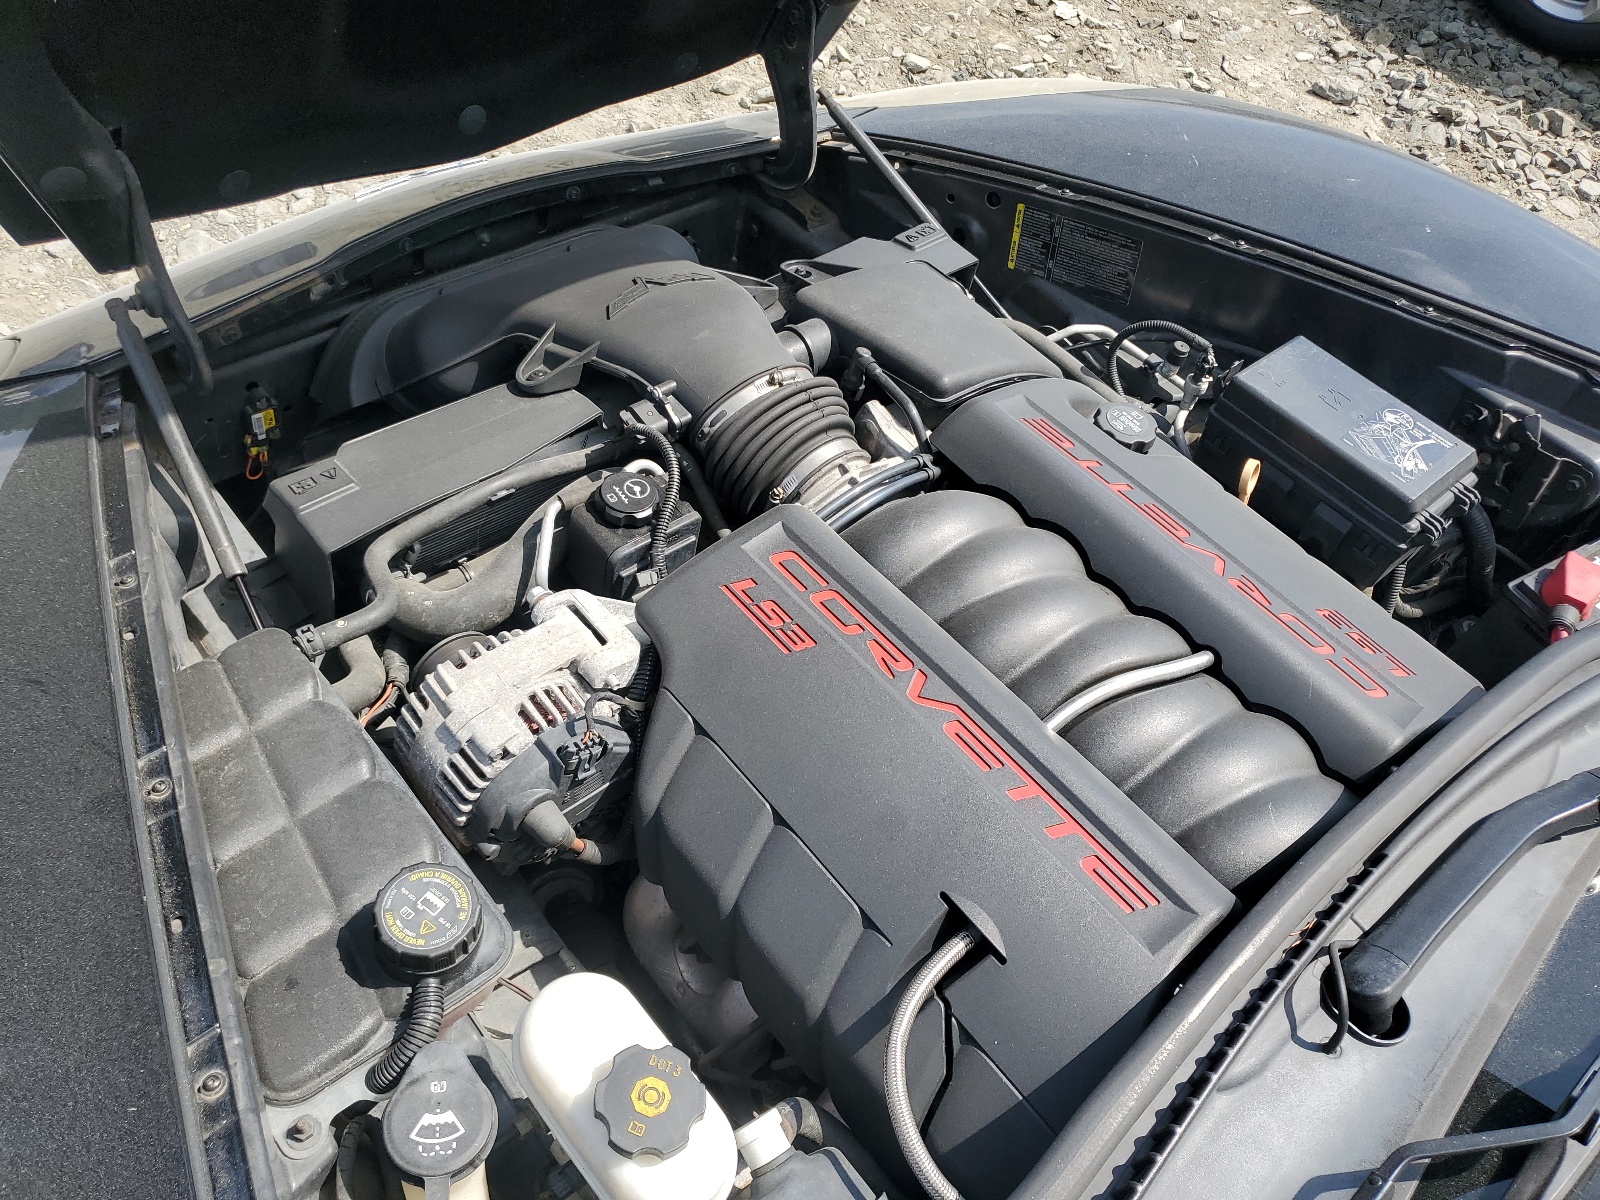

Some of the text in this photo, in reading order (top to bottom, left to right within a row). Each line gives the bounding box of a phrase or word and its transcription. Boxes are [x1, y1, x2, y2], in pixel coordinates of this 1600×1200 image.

[1021, 418, 1389, 698] CORVETTE
[720, 578, 817, 654] LS3
[1315, 607, 1417, 677] LS3
[769, 551, 1160, 913] CORVETTE
[440, 872, 461, 889] OUVRIR
[460, 888, 468, 912] JAMAIS
[385, 912, 395, 925] HOT!
[458, 910, 467, 920] NE
[391, 924, 405, 938] OPEN
[402, 935, 425, 945] NEVER
[648, 1055, 674, 1073] DOT
